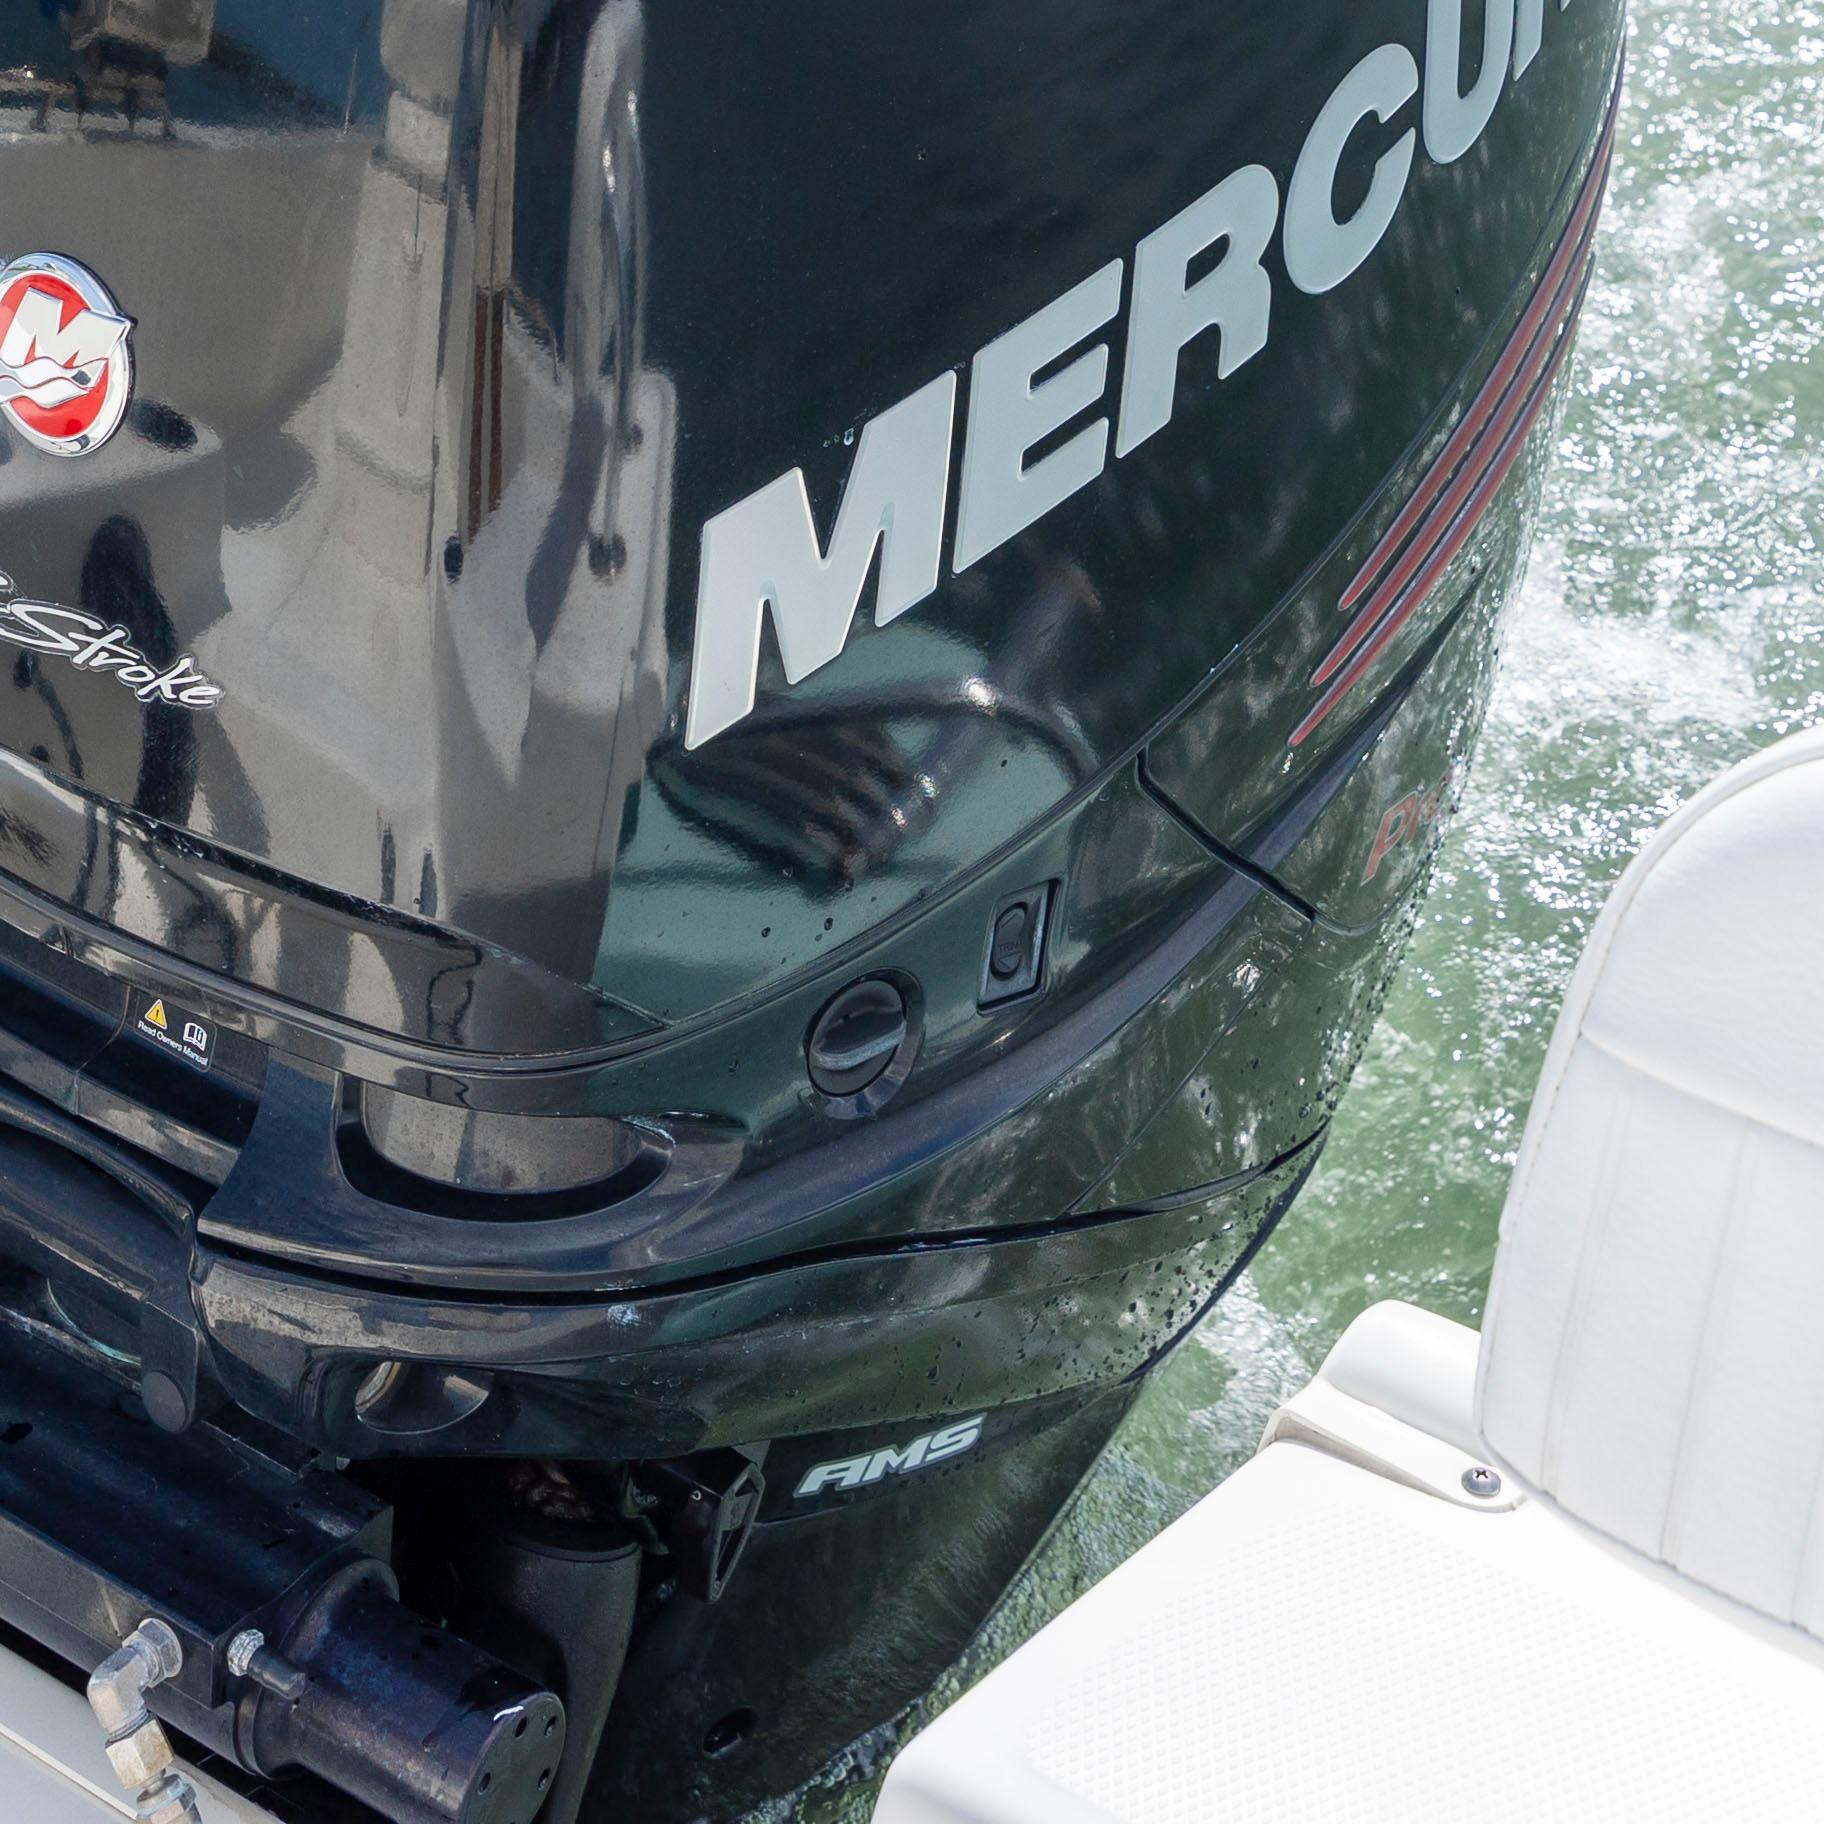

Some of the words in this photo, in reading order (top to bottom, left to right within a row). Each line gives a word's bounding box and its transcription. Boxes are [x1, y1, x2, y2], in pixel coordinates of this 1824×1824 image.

[137, 1019, 157, 1037] Read
[156, 1030, 183, 1052] Owners
[182, 1045, 209, 1067] Manual
[797, 1416, 985, 1495] AMS
